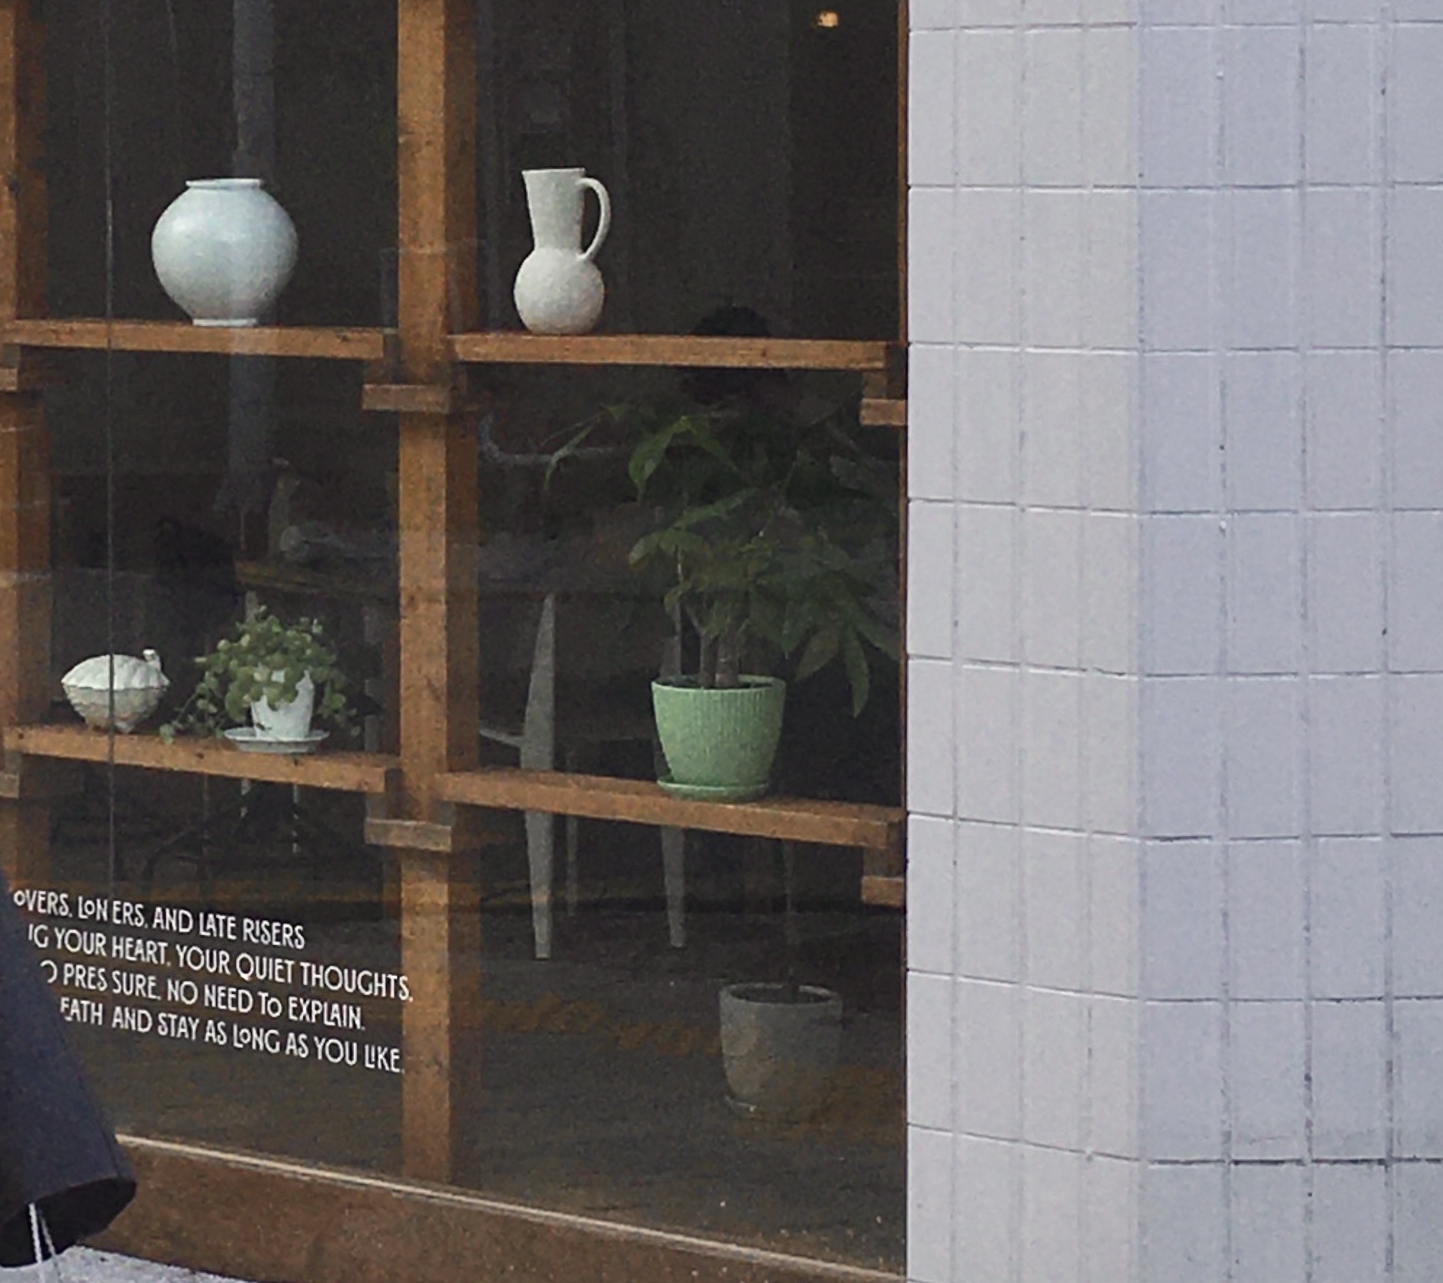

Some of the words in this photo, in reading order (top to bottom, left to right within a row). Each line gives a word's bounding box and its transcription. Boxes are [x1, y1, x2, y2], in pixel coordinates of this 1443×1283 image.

[13, 889, 73, 918] OVERS.
[153, 907, 194, 933] AND
[199, 912, 238, 940] LATE
[242, 918, 306, 950] RISERS
[54, 927, 107, 957] YOUR
[175, 944, 231, 975] YOUR
[235, 952, 295, 984] QUIET
[300, 961, 414, 1002] THOUGHTS.
[166, 977, 199, 1005] NO
[203, 984, 253, 1014] NEED
[257, 991, 283, 1018] TO
[288, 995, 366, 1031] EXPLAIN.
[111, 1005, 153, 1033] AND
[157, 1012, 200, 1041] STAY
[204, 1019, 228, 1046] AS
[233, 1023, 281, 1054] LONG
[285, 1031, 309, 1059] AS
[313, 1035, 358, 1066] YOU
